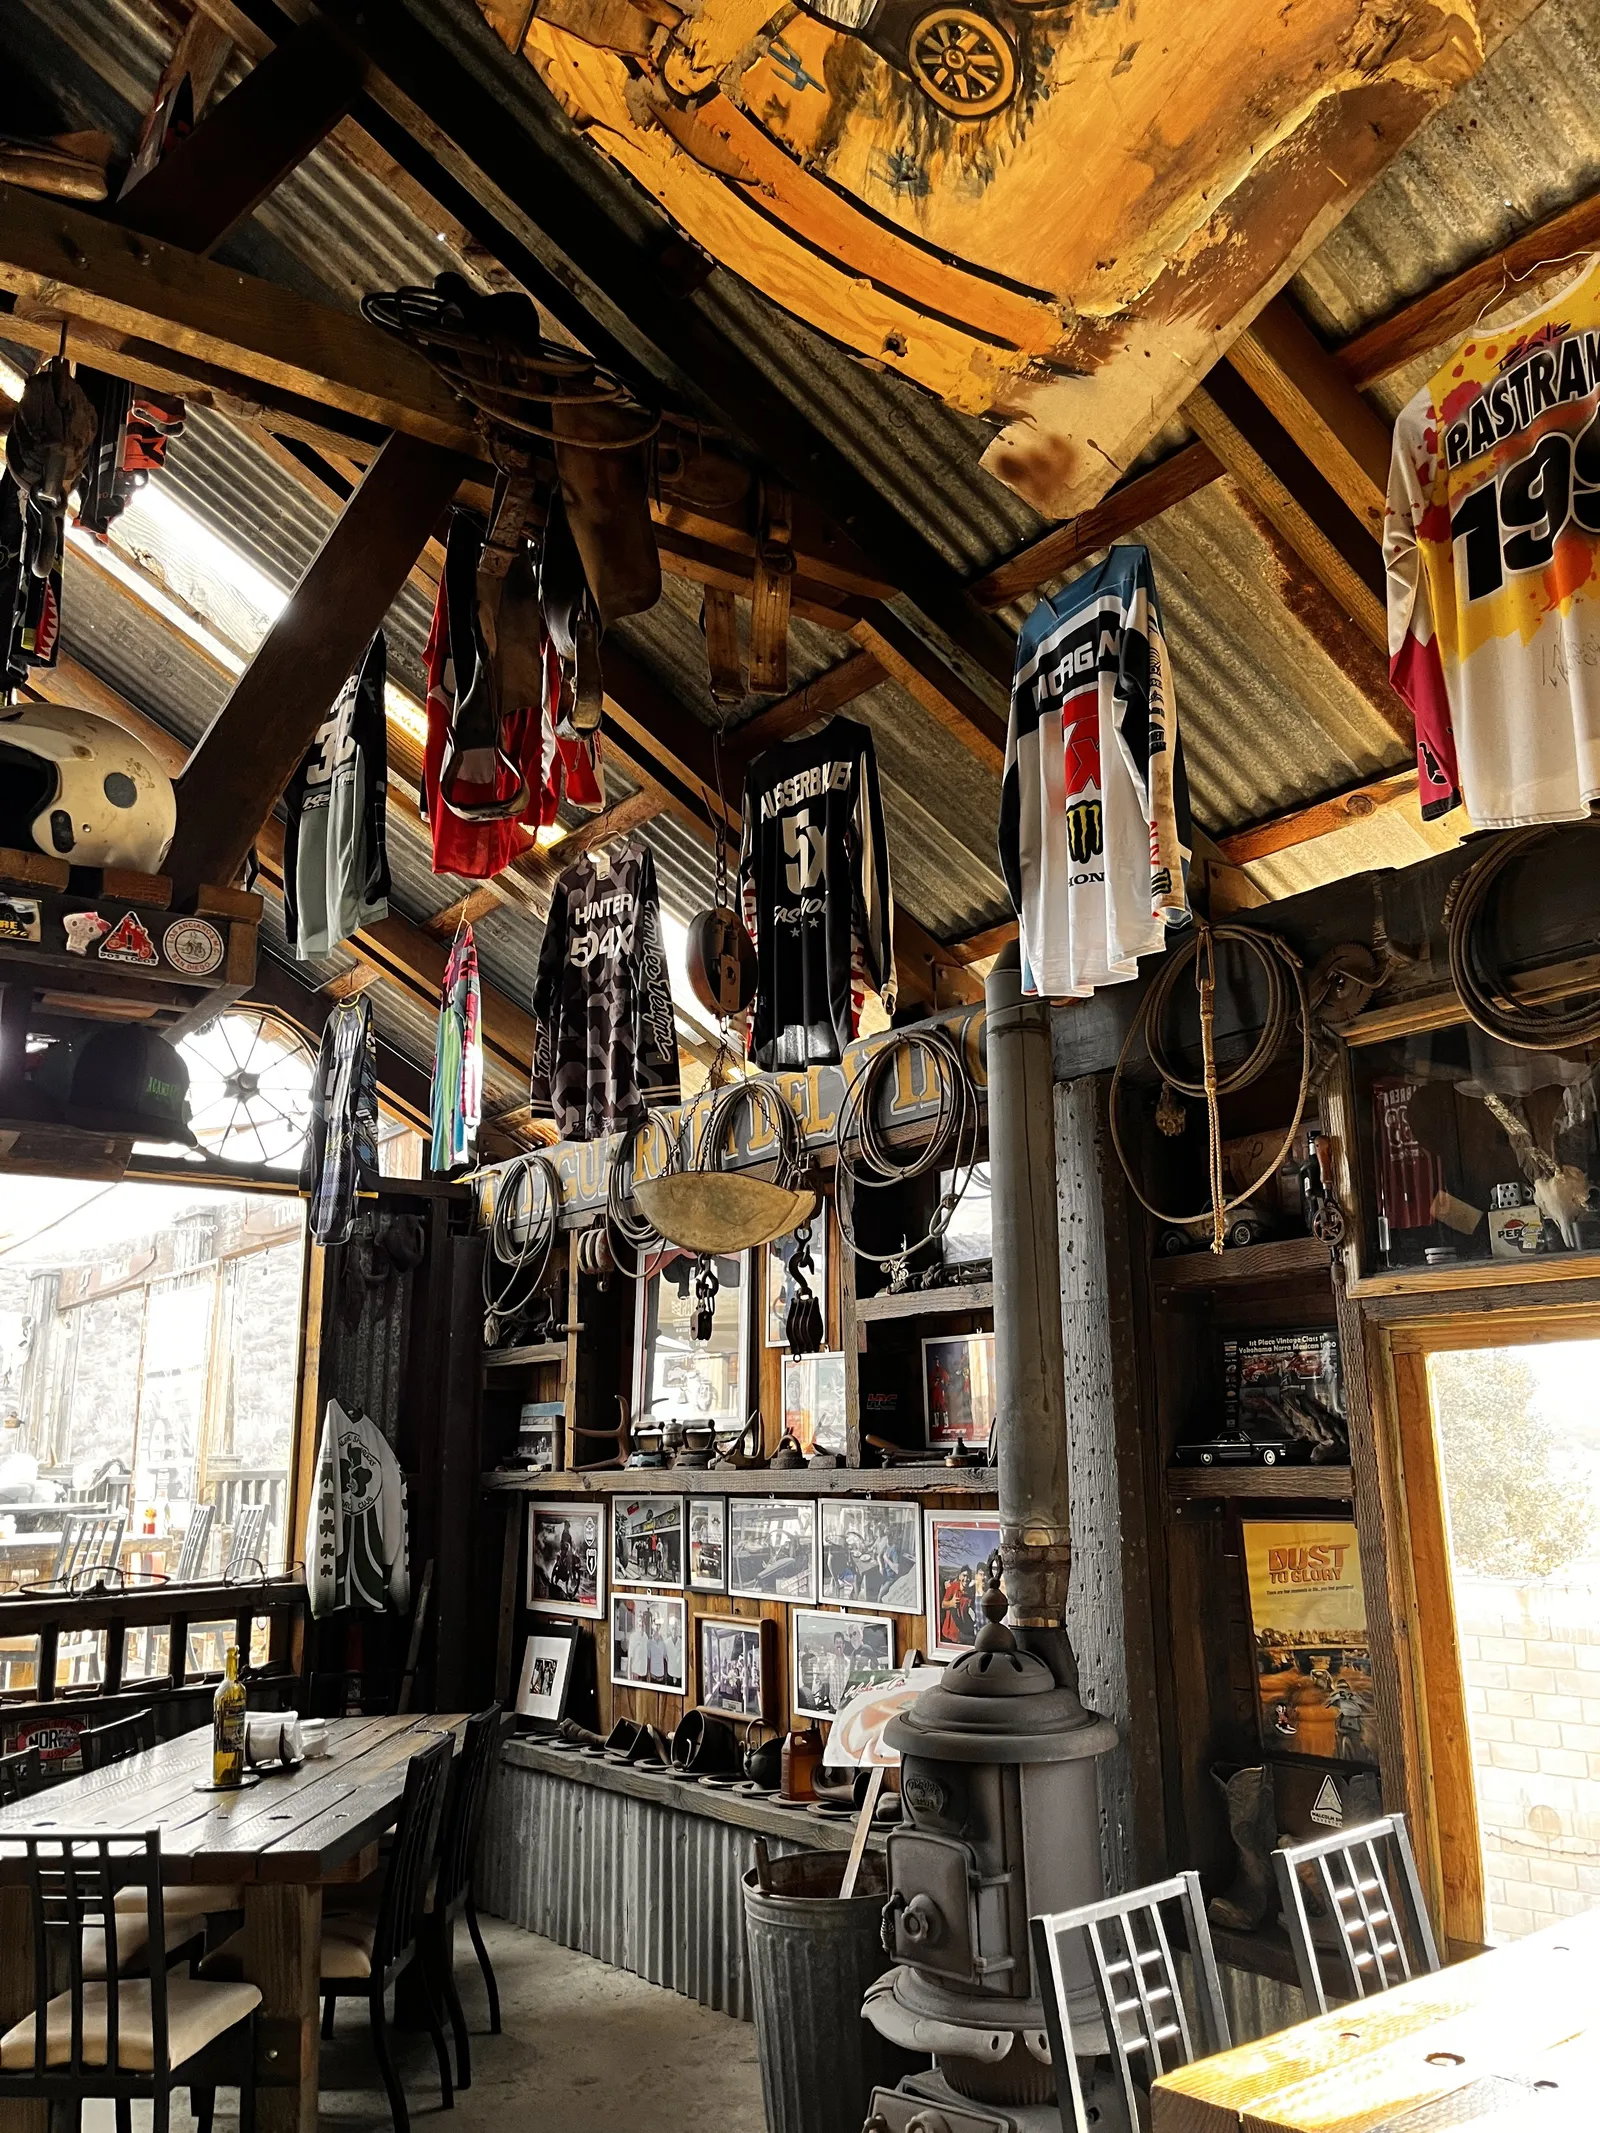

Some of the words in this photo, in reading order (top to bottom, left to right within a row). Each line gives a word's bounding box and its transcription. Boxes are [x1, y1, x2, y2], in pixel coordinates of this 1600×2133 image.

[1032, 629, 1121, 711] MORGN
[575, 893, 633, 926] HUNTER
[178, 922, 215, 940] ANCIANOS
[171, 953, 185, 968] SAN
[187, 961, 211, 971] DIEGO
[1238, 1346, 1272, 1354] Yokohama
[1273, 1344, 1292, 1352] Norra
[1292, 1342, 1319, 1350] Mexican
[1276, 1337, 1301, 1346] Vintage
[1301, 1335, 1319, 1343] Class
[1268, 1544, 1350, 1571] DUST
[1269, 1570, 1289, 1584] TO
[1291, 1567, 1343, 1583] GLORY
[28, 1729, 62, 1749] NOR
